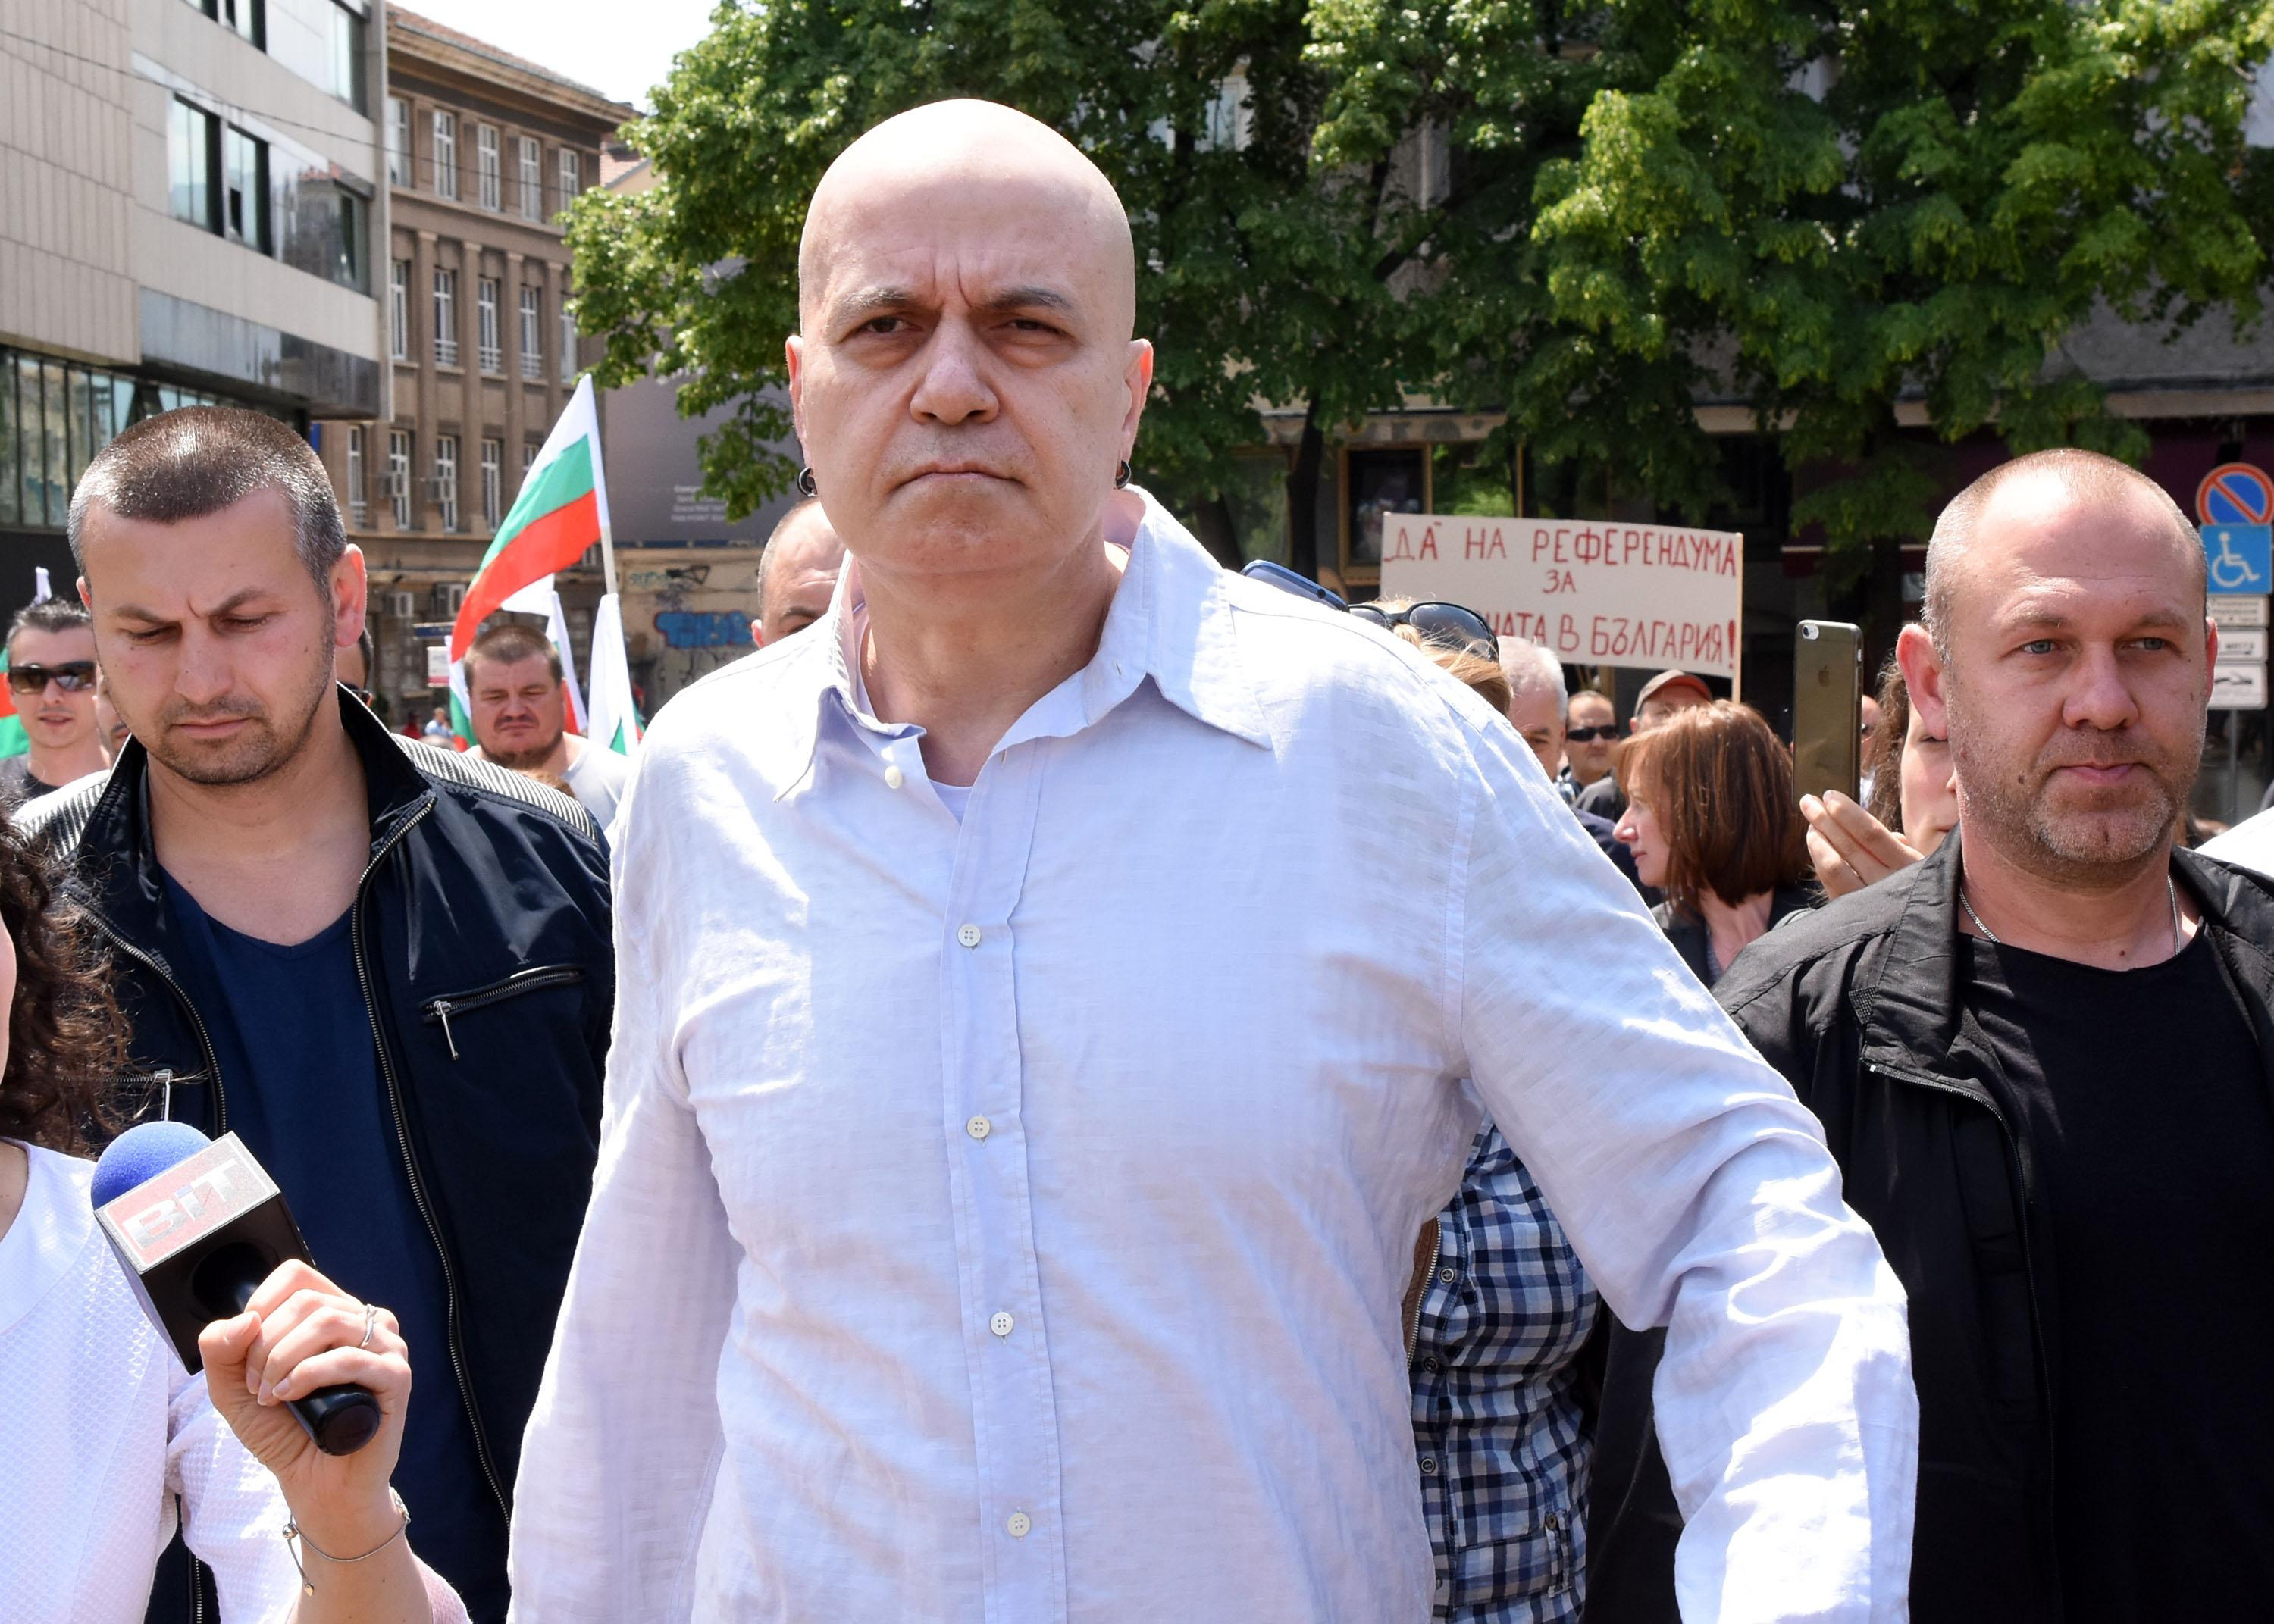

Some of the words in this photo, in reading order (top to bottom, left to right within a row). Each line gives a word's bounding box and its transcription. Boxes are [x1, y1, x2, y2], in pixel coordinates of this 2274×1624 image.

[1465, 527, 1507, 560] НА
[1532, 527, 1737, 577] РЕФЕРЕНДУМА
[1543, 569, 1577, 593] ЗА
[1558, 613, 1580, 652] В
